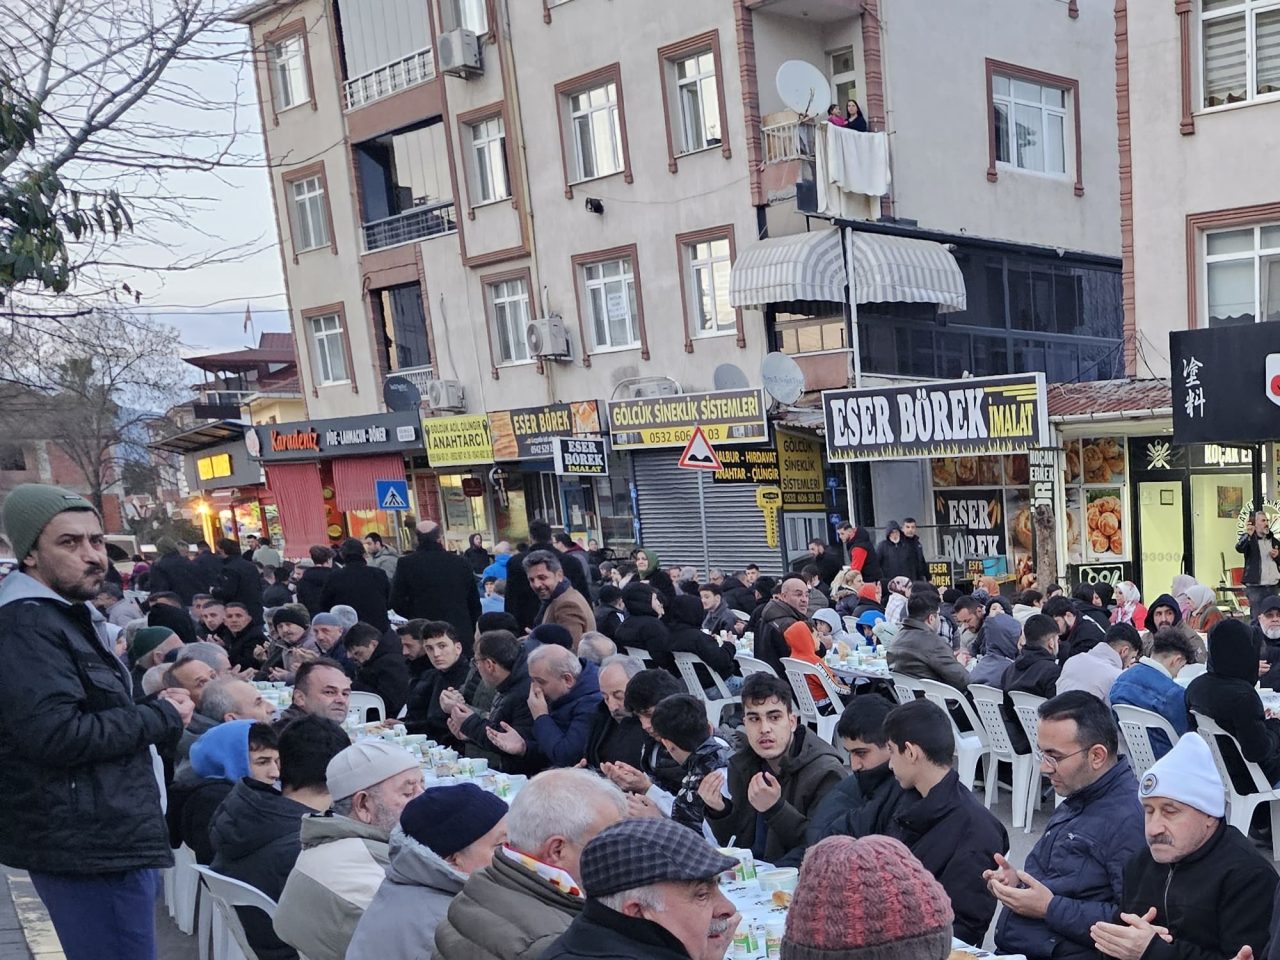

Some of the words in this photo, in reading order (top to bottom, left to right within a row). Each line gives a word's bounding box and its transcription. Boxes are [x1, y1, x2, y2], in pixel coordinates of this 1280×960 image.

[613, 401, 654, 426] GÖLCÜK
[654, 397, 700, 424] SİNEKLİK
[700, 391, 760, 421] SİSTEMLERİ
[513, 413, 539, 436] ESER
[538, 408, 571, 433] BÖREK
[830, 396, 895, 447] ESER
[896, 387, 988, 443] BÖREK
[988, 396, 1034, 438] İMALAT
[270, 426, 320, 452] Karadeniz
[433, 432, 485, 450] ANAHTARCI
[649, 431, 672, 444] 0532
[708, 428, 720, 440] 03
[567, 440, 598, 453] ESER
[783, 438, 814, 453] GÖLCÜK
[563, 452, 605, 466] BÖREK
[745, 450, 777, 464] HIRDAVAT
[1029, 450, 1054, 466] KOÇAK
[1204, 445, 1240, 467] KOÇAK
[568, 464, 602, 473] İMALAT
[751, 463, 779, 482] ÇİLİNGİR
[784, 457, 816, 472] SİNEKLİK
[1030, 467, 1055, 482] ERKEK
[782, 475, 821, 491] SİSTEMLERİ
[948, 499, 991, 530] ESER
[943, 531, 1000, 565] BÖREK
[928, 562, 947, 574] ESER
[930, 574, 951, 587] ÖREK
